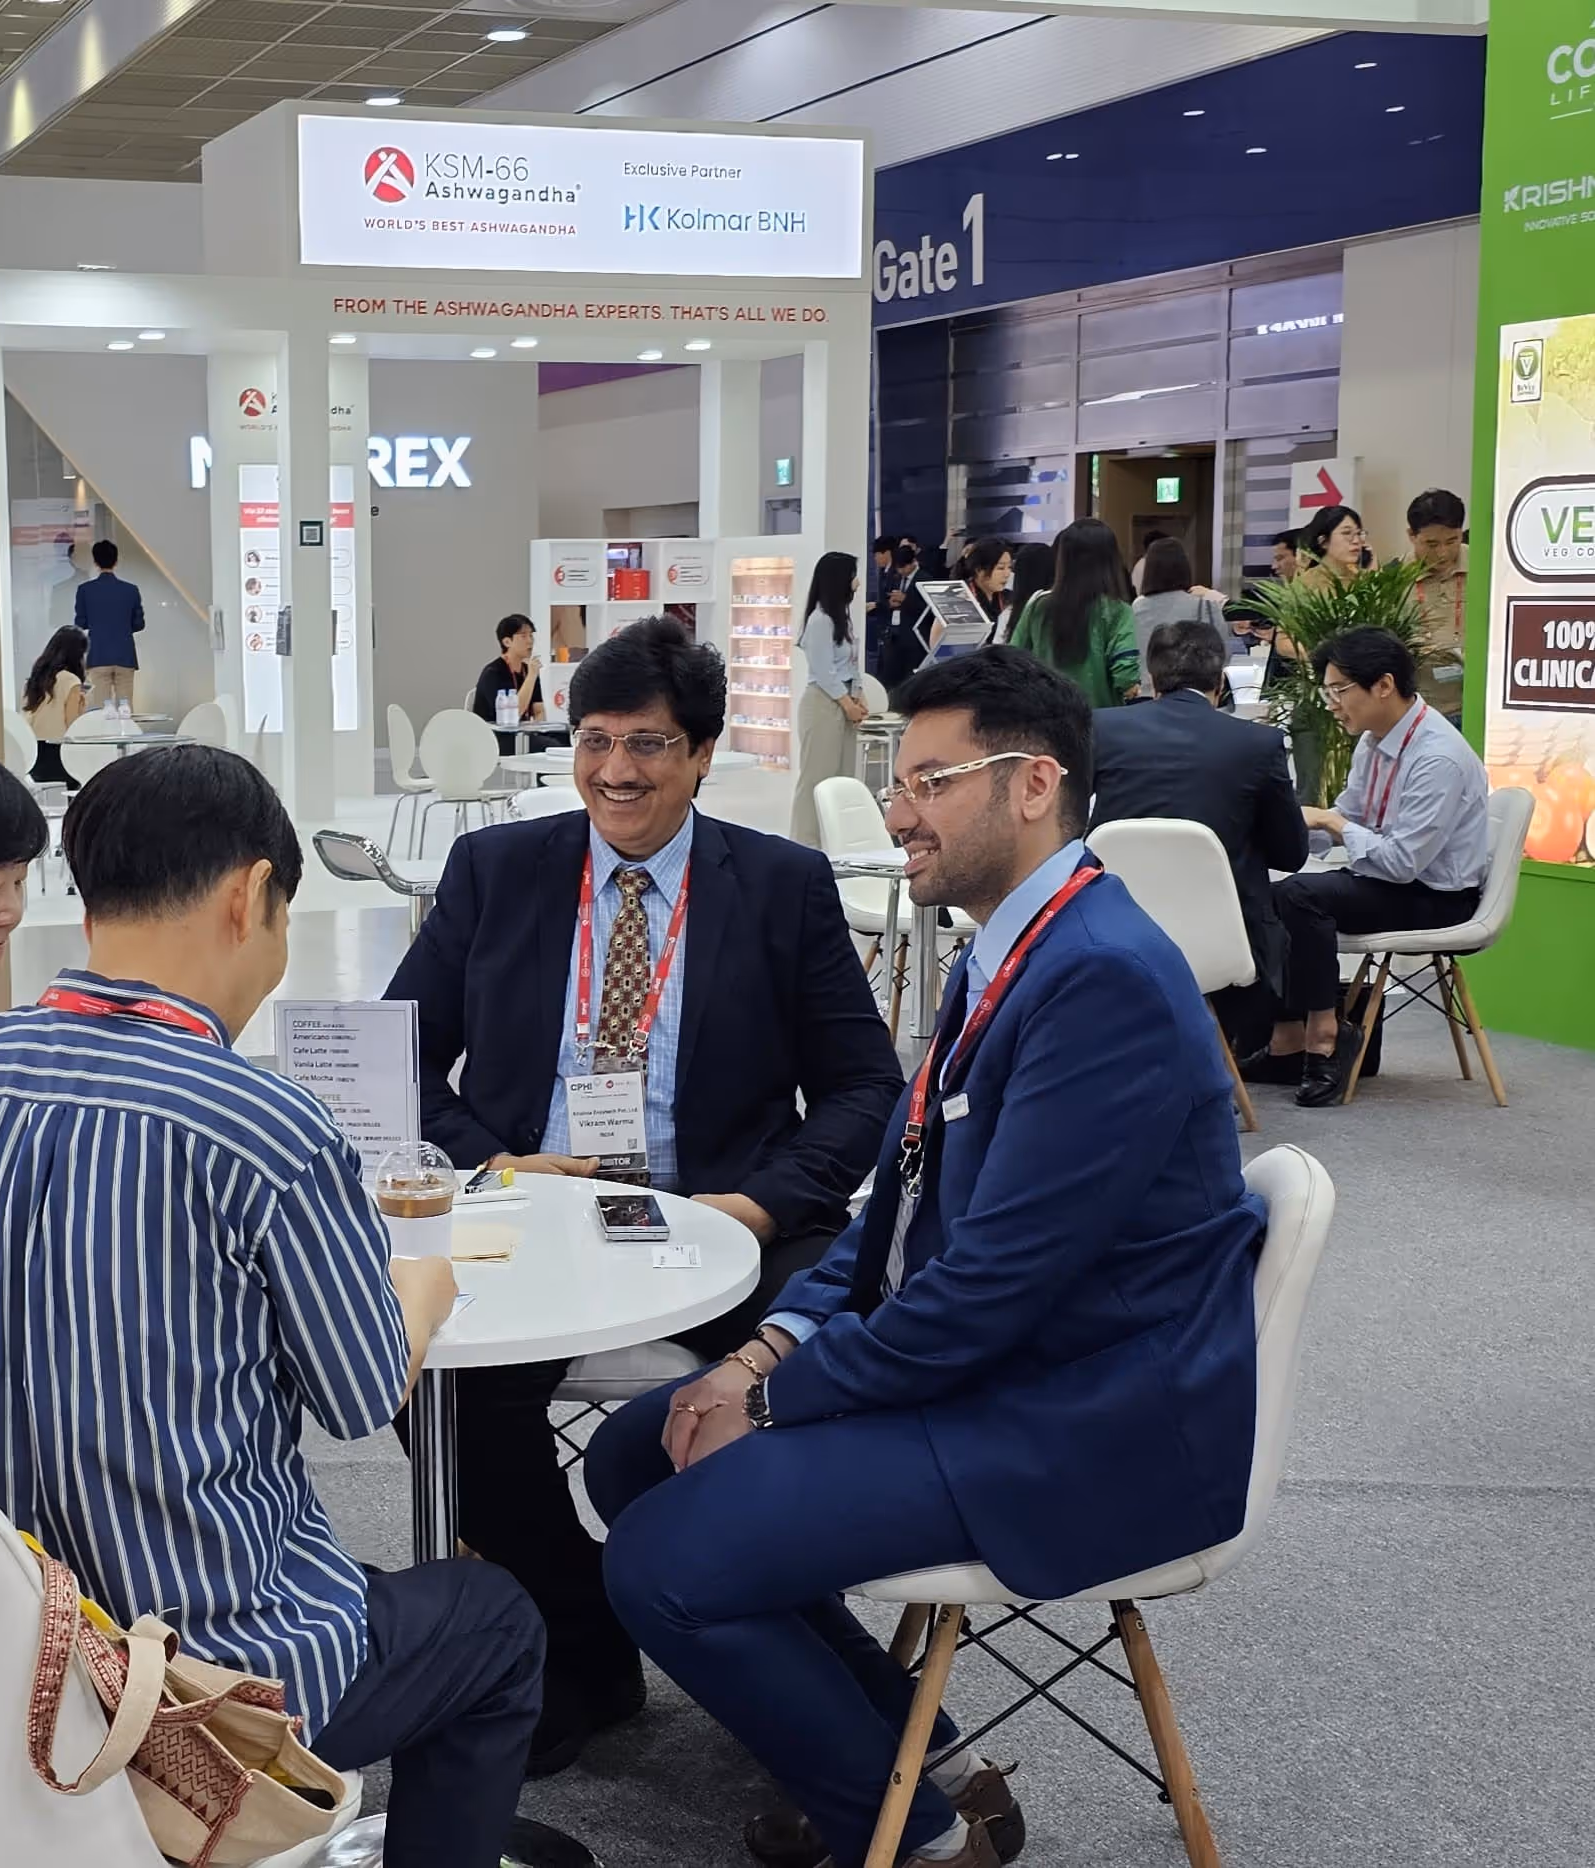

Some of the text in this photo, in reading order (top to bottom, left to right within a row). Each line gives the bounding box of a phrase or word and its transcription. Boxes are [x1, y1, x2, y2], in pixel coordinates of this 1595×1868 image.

[425, 153, 529, 181] KSM-66
[624, 162, 742, 179] Exclusive Partner
[364, 218, 576, 235] WORLD'S BEST ASHWAGANDHA
[667, 207, 752, 231] Kolmar
[758, 211, 806, 232] BNH
[873, 192, 984, 302] Gate 1
[334, 299, 830, 322] FROM THE ASHWAGANDHA EXPERTS. THAT'S ALL WE DO.
[1543, 548, 1568, 557] VEG
